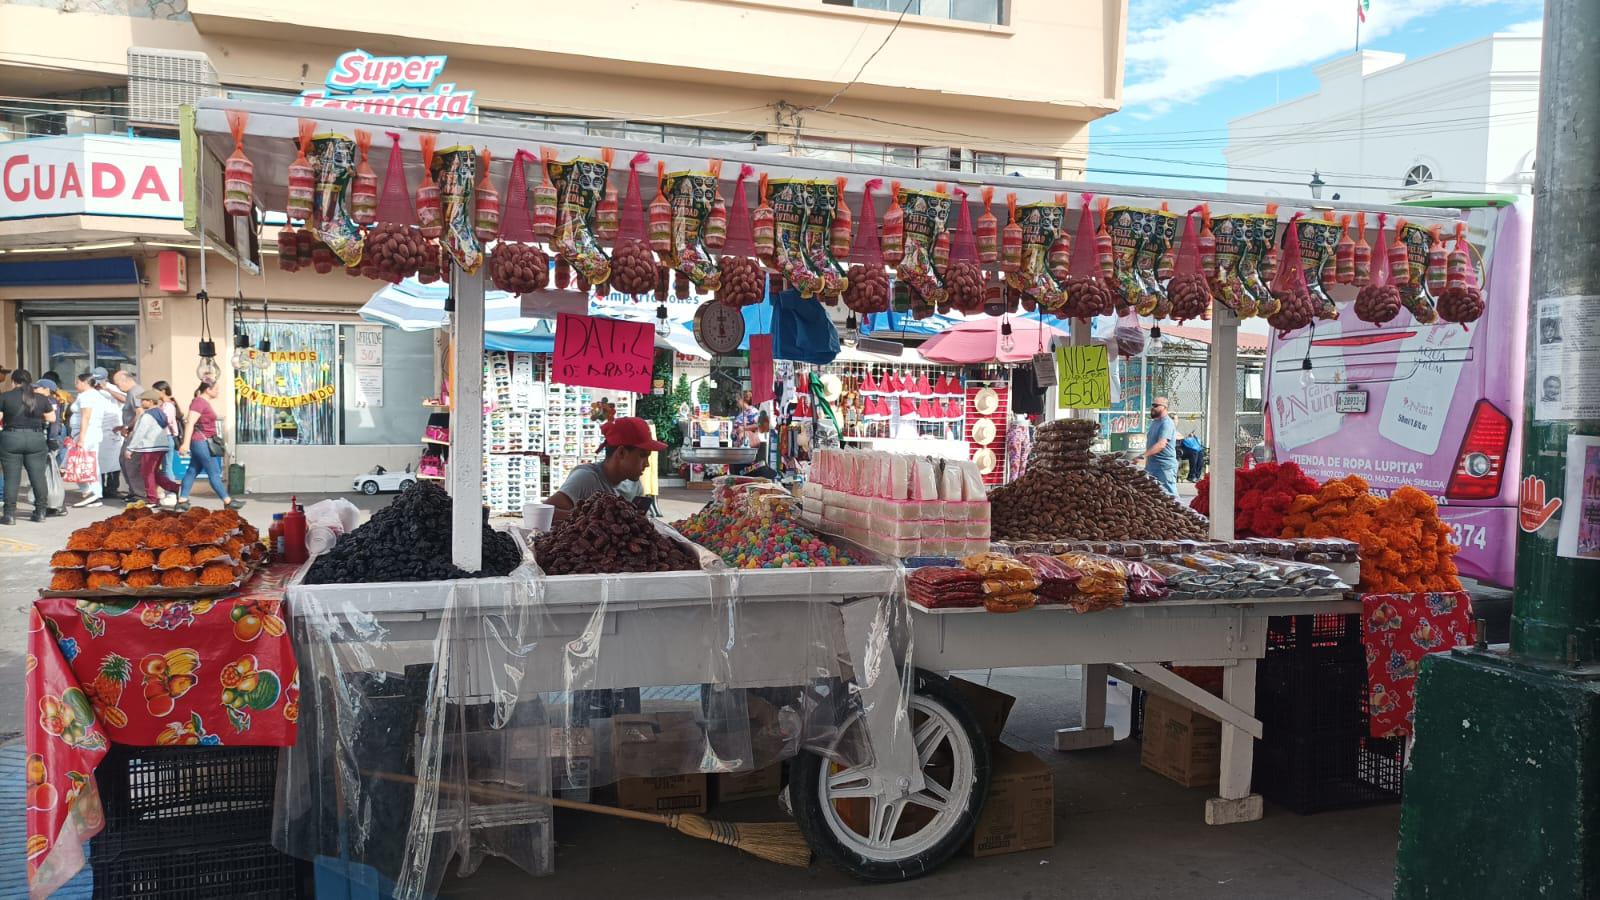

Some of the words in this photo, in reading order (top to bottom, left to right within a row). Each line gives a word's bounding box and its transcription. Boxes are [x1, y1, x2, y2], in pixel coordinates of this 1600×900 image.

[334, 55, 440, 86] Super
[249, 351, 317, 361] ETAMOS
[234, 375, 336, 407] CONTRATANDO
[1327, 456, 1341, 468] DE
[1342, 458, 1372, 471] ROPA
[1446, 523, 1487, 549] 374
